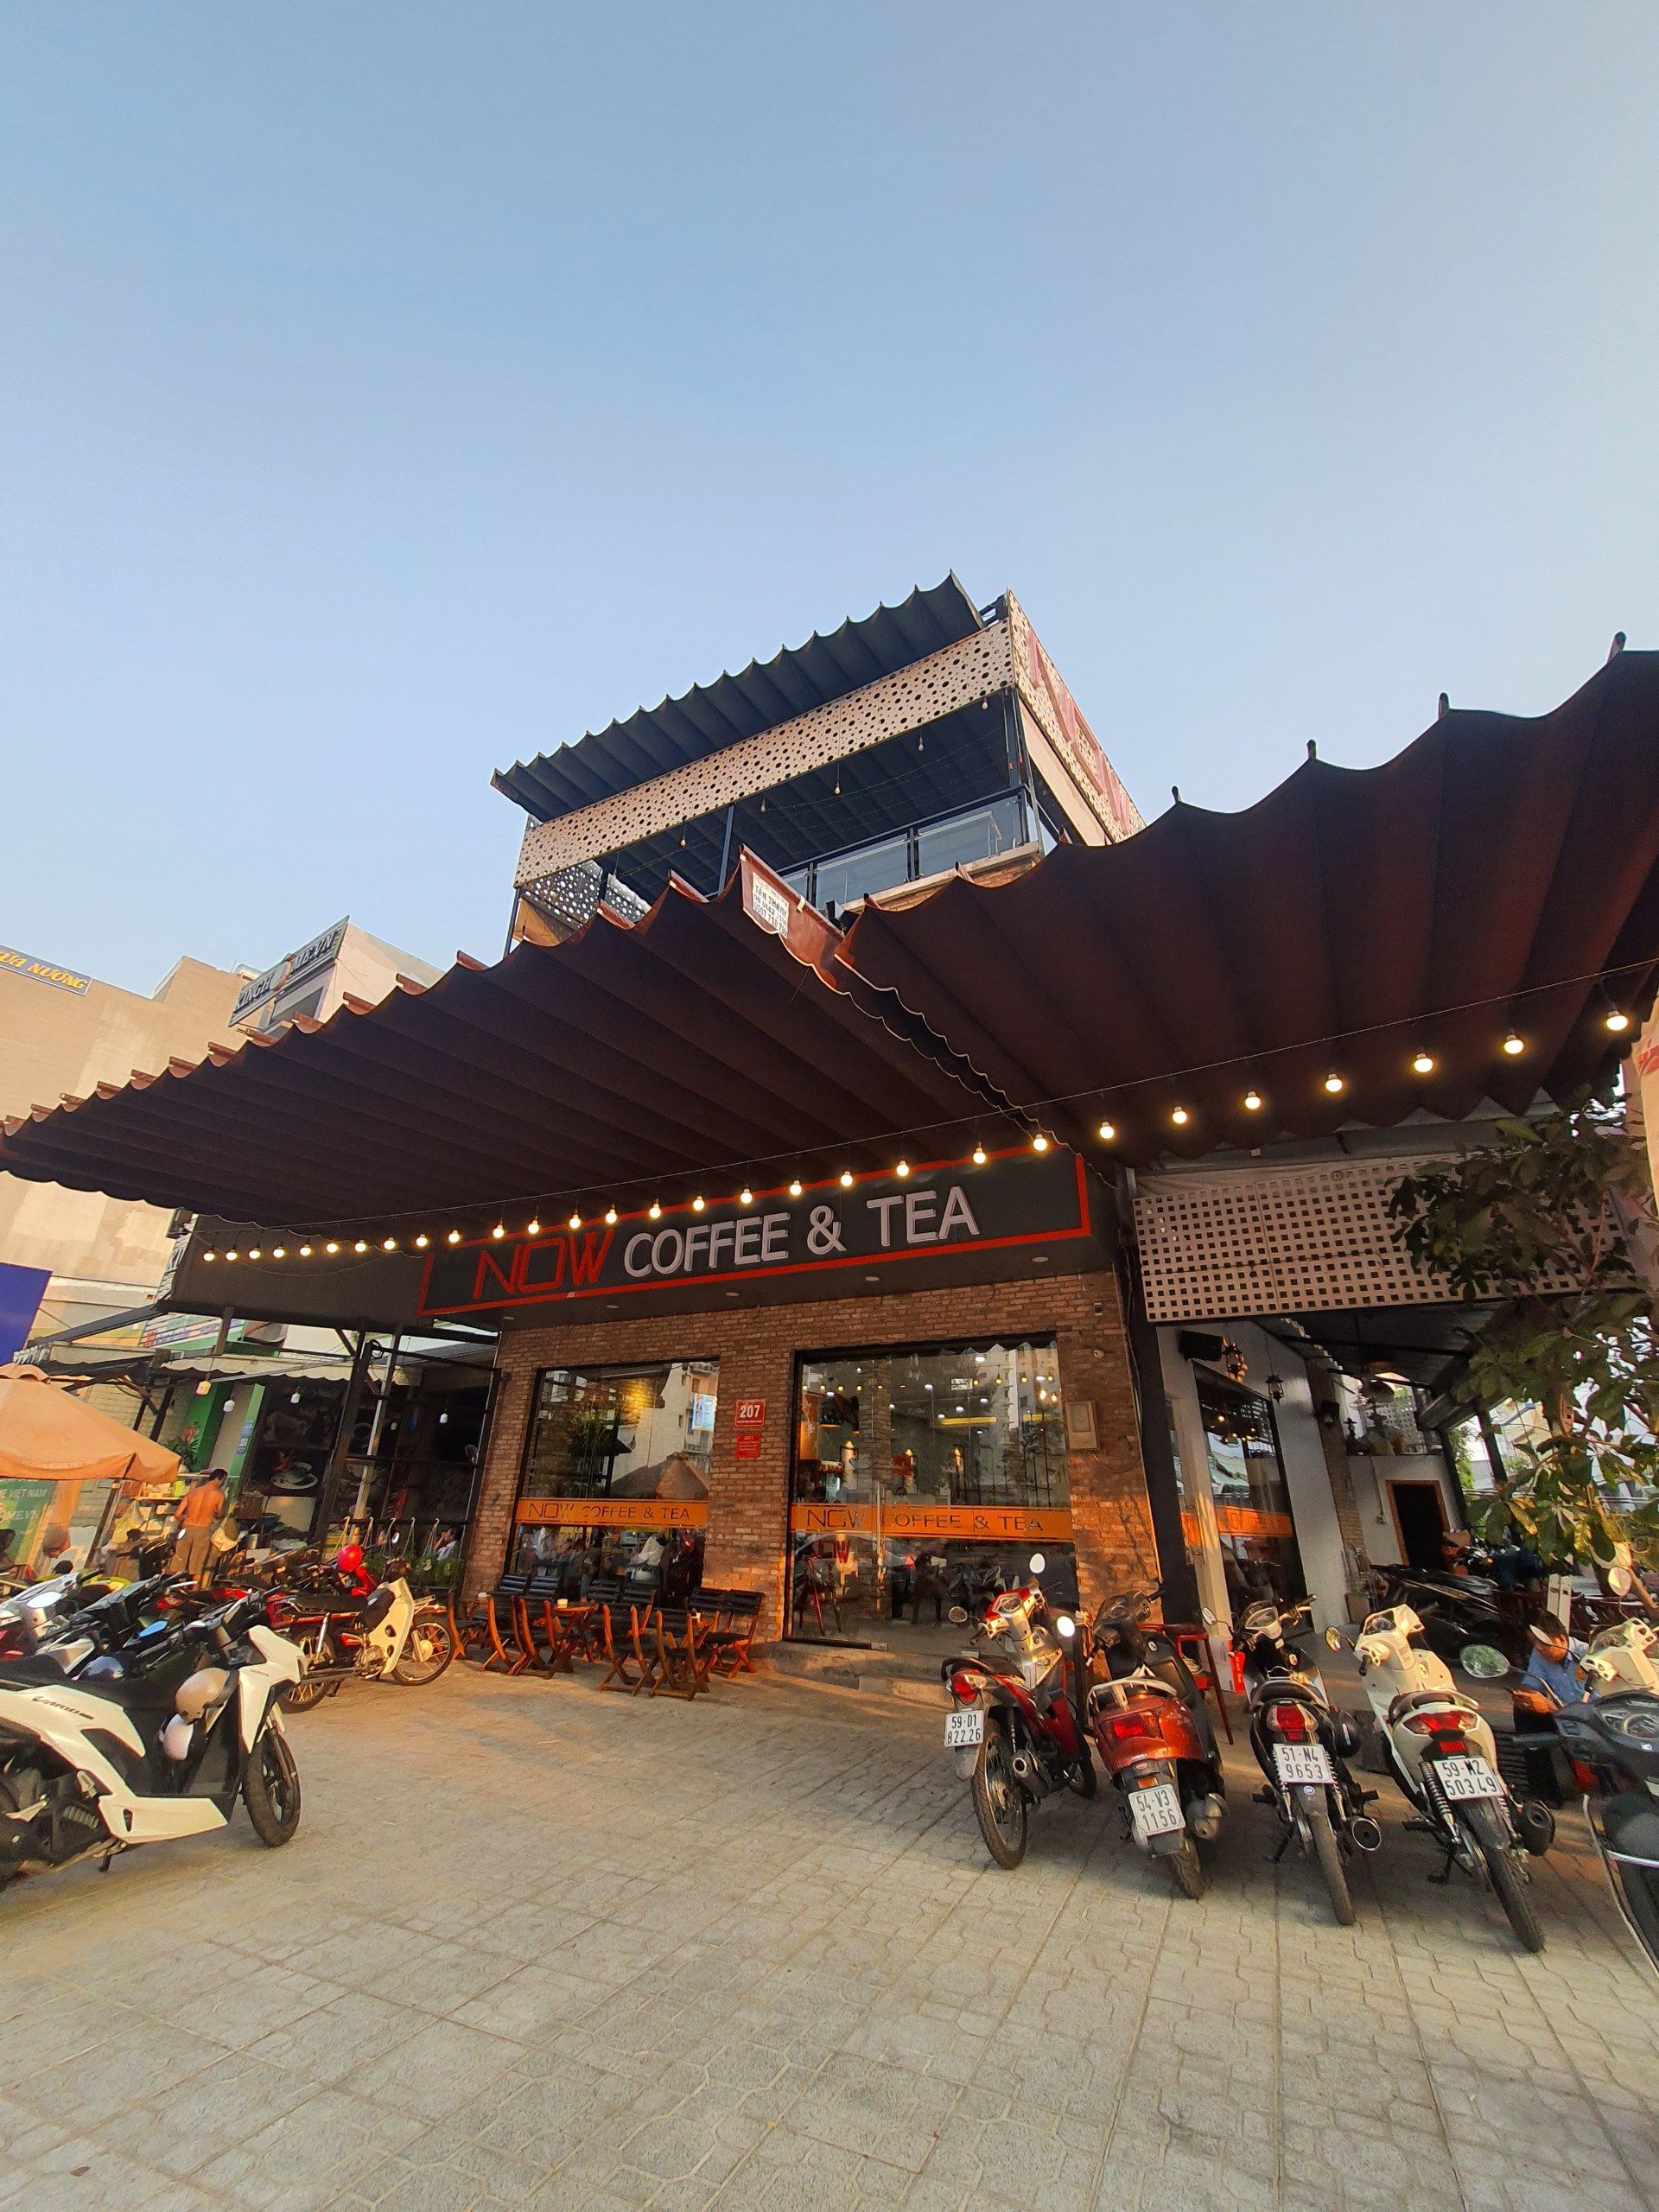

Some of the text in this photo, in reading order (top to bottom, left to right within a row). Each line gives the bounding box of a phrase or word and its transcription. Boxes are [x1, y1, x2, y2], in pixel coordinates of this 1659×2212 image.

[473, 1185, 981, 1300] NOW COFFEE & TEA
[740, 1404, 761, 1419] 207
[528, 1503, 690, 1520] NOW COFFEE & TEA
[805, 1509, 1045, 1532] NOW COFFEE & TEA
[951, 1713, 976, 1729] 59-D1
[947, 1727, 982, 1745] 822.26
[1281, 1746, 1319, 1763] 51-N4
[1286, 1764, 1324, 1780] 9653
[1444, 1777, 1497, 1796] 503.49
[1135, 1789, 1171, 1812] 54-V3
[1142, 1808, 1178, 1831] 1156
